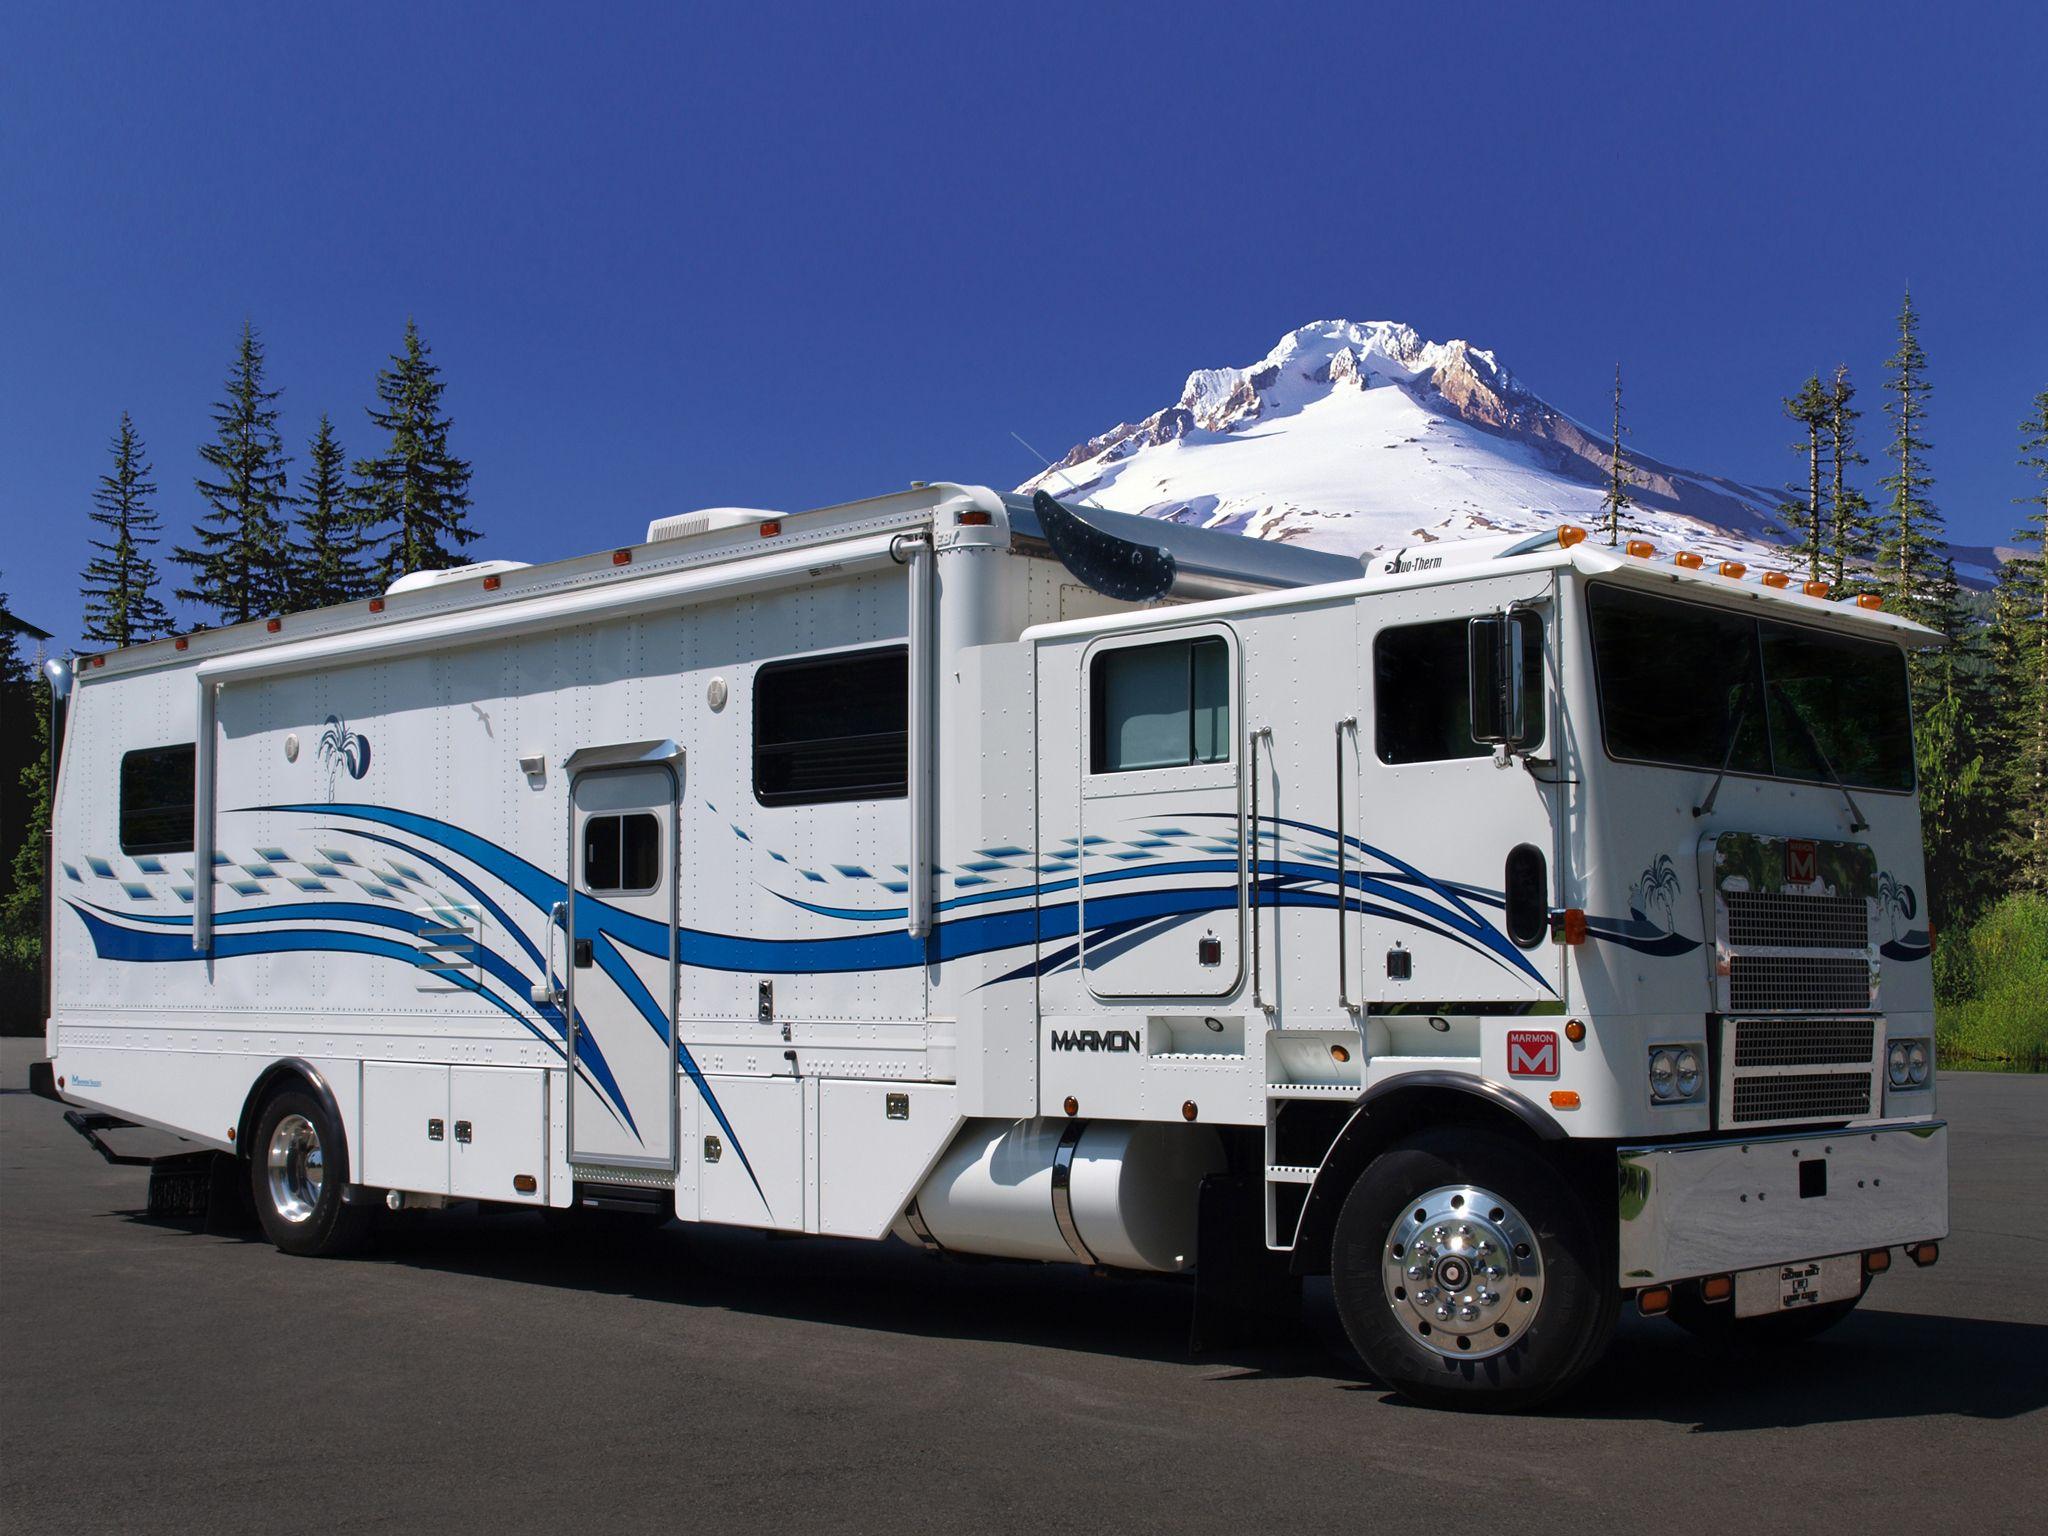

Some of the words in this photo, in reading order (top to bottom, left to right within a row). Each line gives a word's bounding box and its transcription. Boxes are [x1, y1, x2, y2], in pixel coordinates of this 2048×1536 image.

[1791, 852, 1814, 878] M
[1051, 1029, 1140, 1053] MARMON
[1511, 1034, 1553, 1042] MARMON
[1511, 1044, 1553, 1072] M
